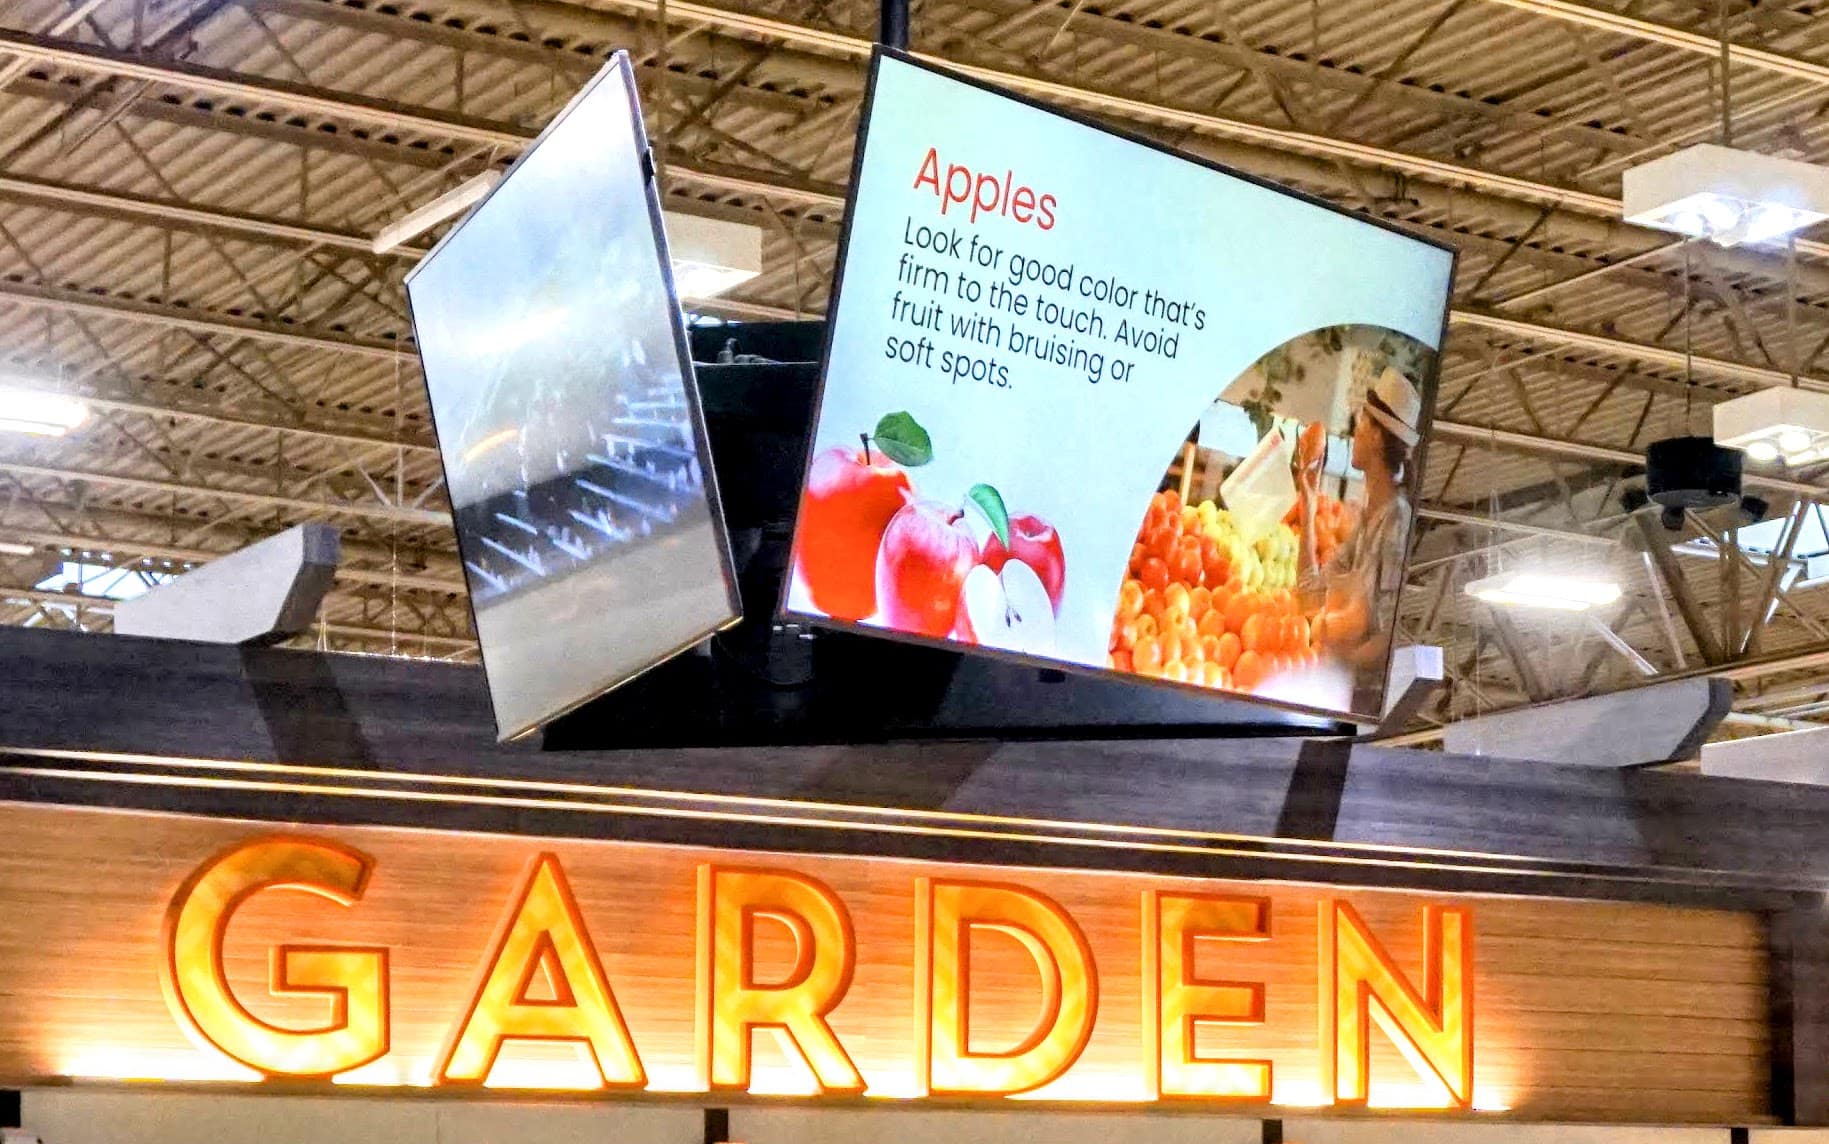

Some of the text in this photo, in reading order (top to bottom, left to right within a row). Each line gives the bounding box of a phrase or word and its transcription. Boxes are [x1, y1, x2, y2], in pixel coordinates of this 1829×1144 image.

[914, 147, 1058, 231] Apples
[898, 253, 1180, 361] firm to the touch. Avoid
[904, 216, 1206, 332] Look for good color that's
[885, 334, 1014, 391] soft spots.
[890, 292, 1136, 384] fruit with bruising or
[162, 834, 1475, 1112] GARDEN
